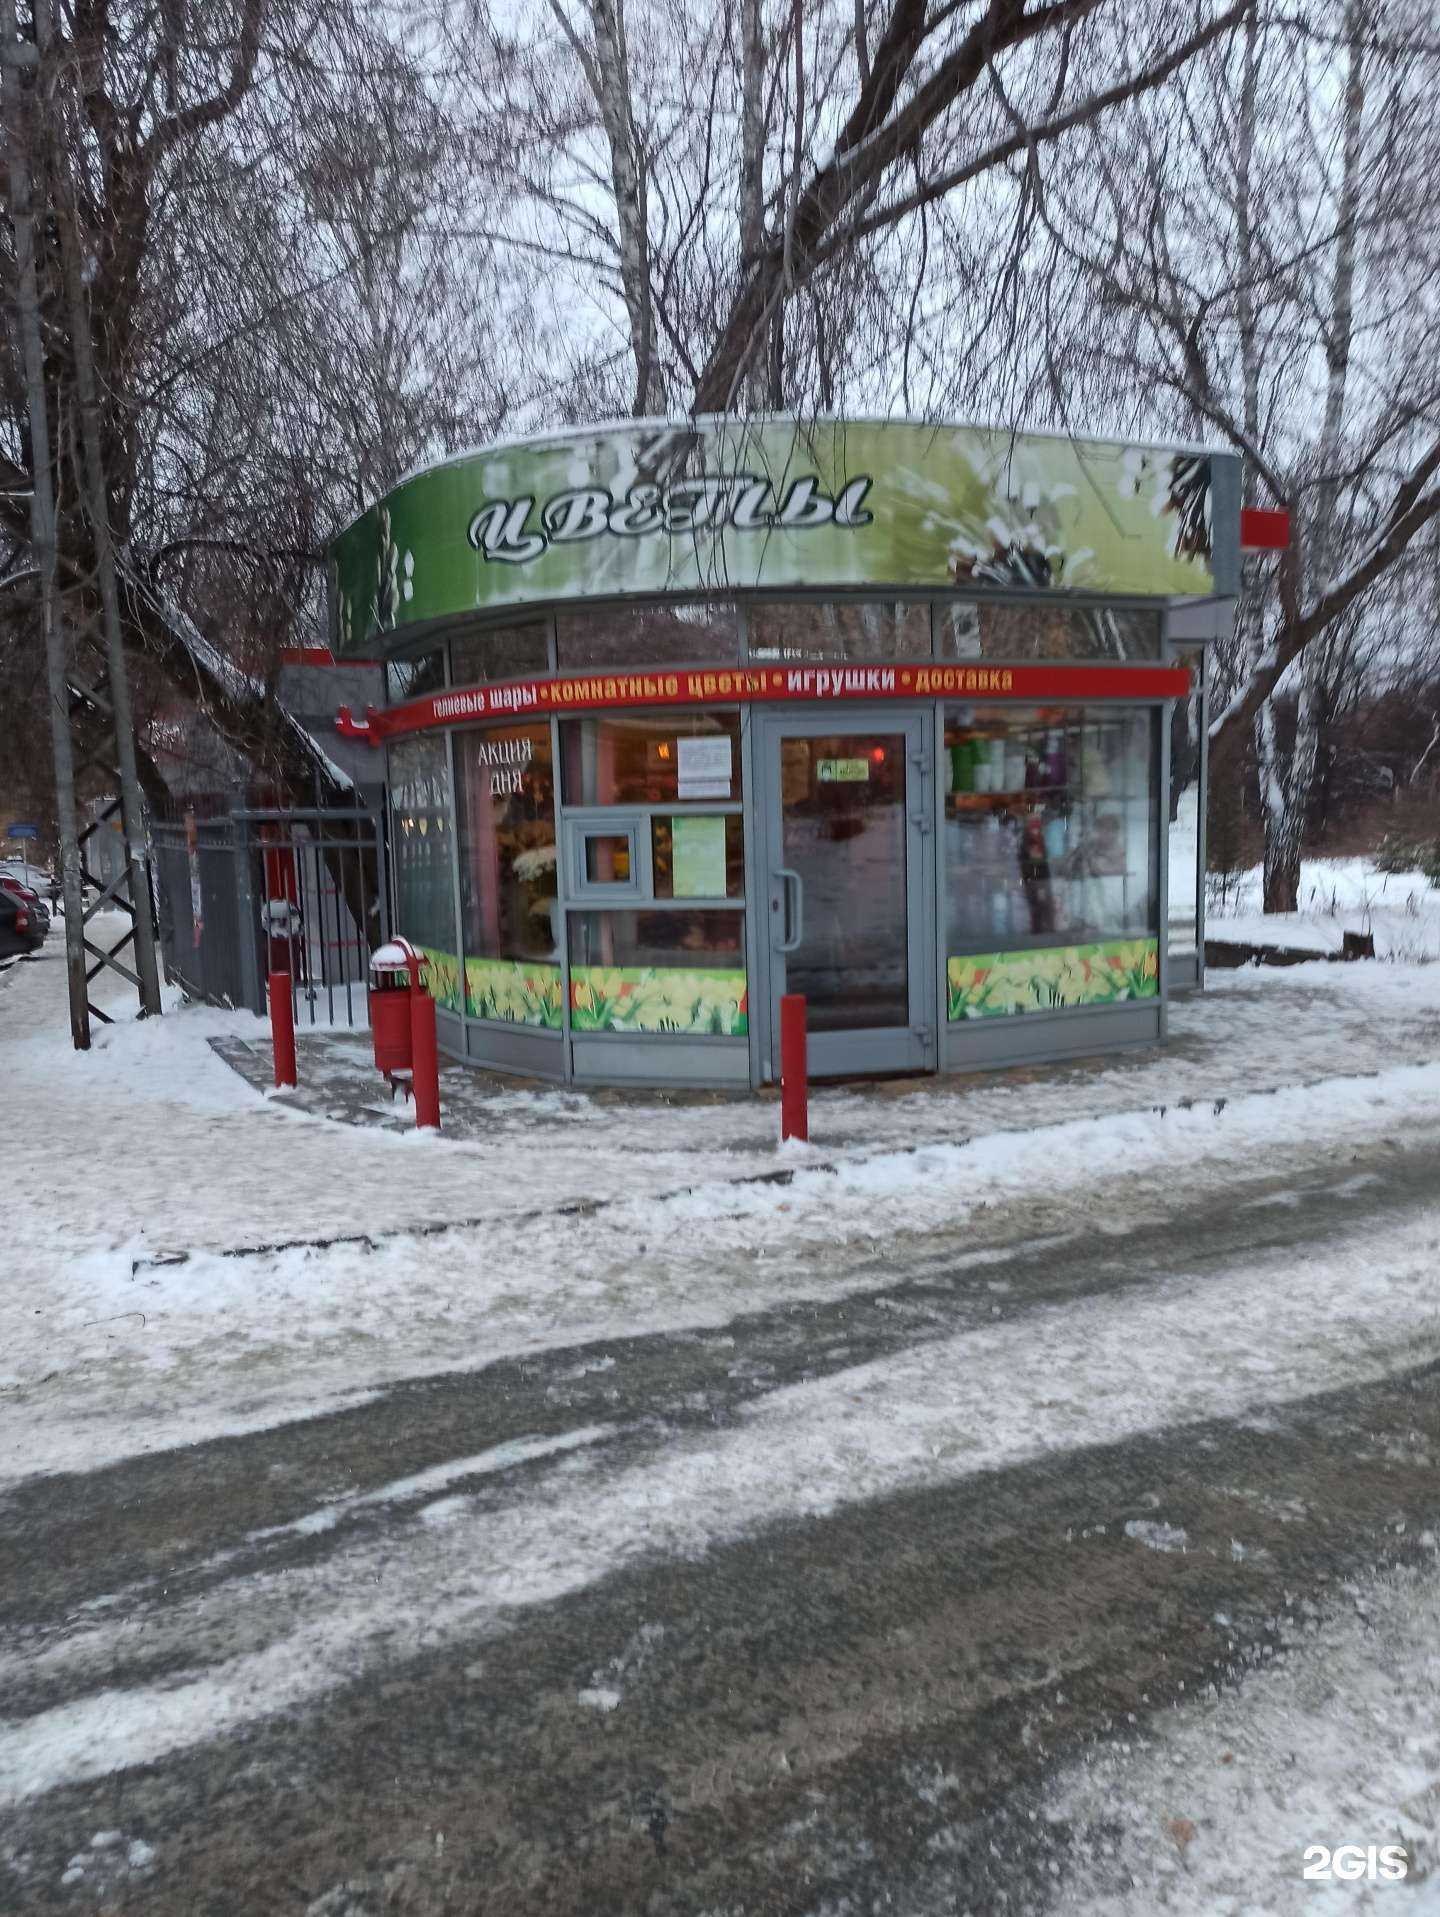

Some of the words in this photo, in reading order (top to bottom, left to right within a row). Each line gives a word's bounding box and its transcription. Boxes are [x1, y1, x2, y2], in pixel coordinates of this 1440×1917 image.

[490, 684, 537, 711] шары
[550, 673, 678, 702] комнатные
[687, 671, 767, 699] цветы
[787, 669, 895, 696] игрушки
[915, 669, 1013, 693] доставка
[478, 737, 533, 766] АКЦИЯ
[489, 768, 525, 796] ДНЯ
